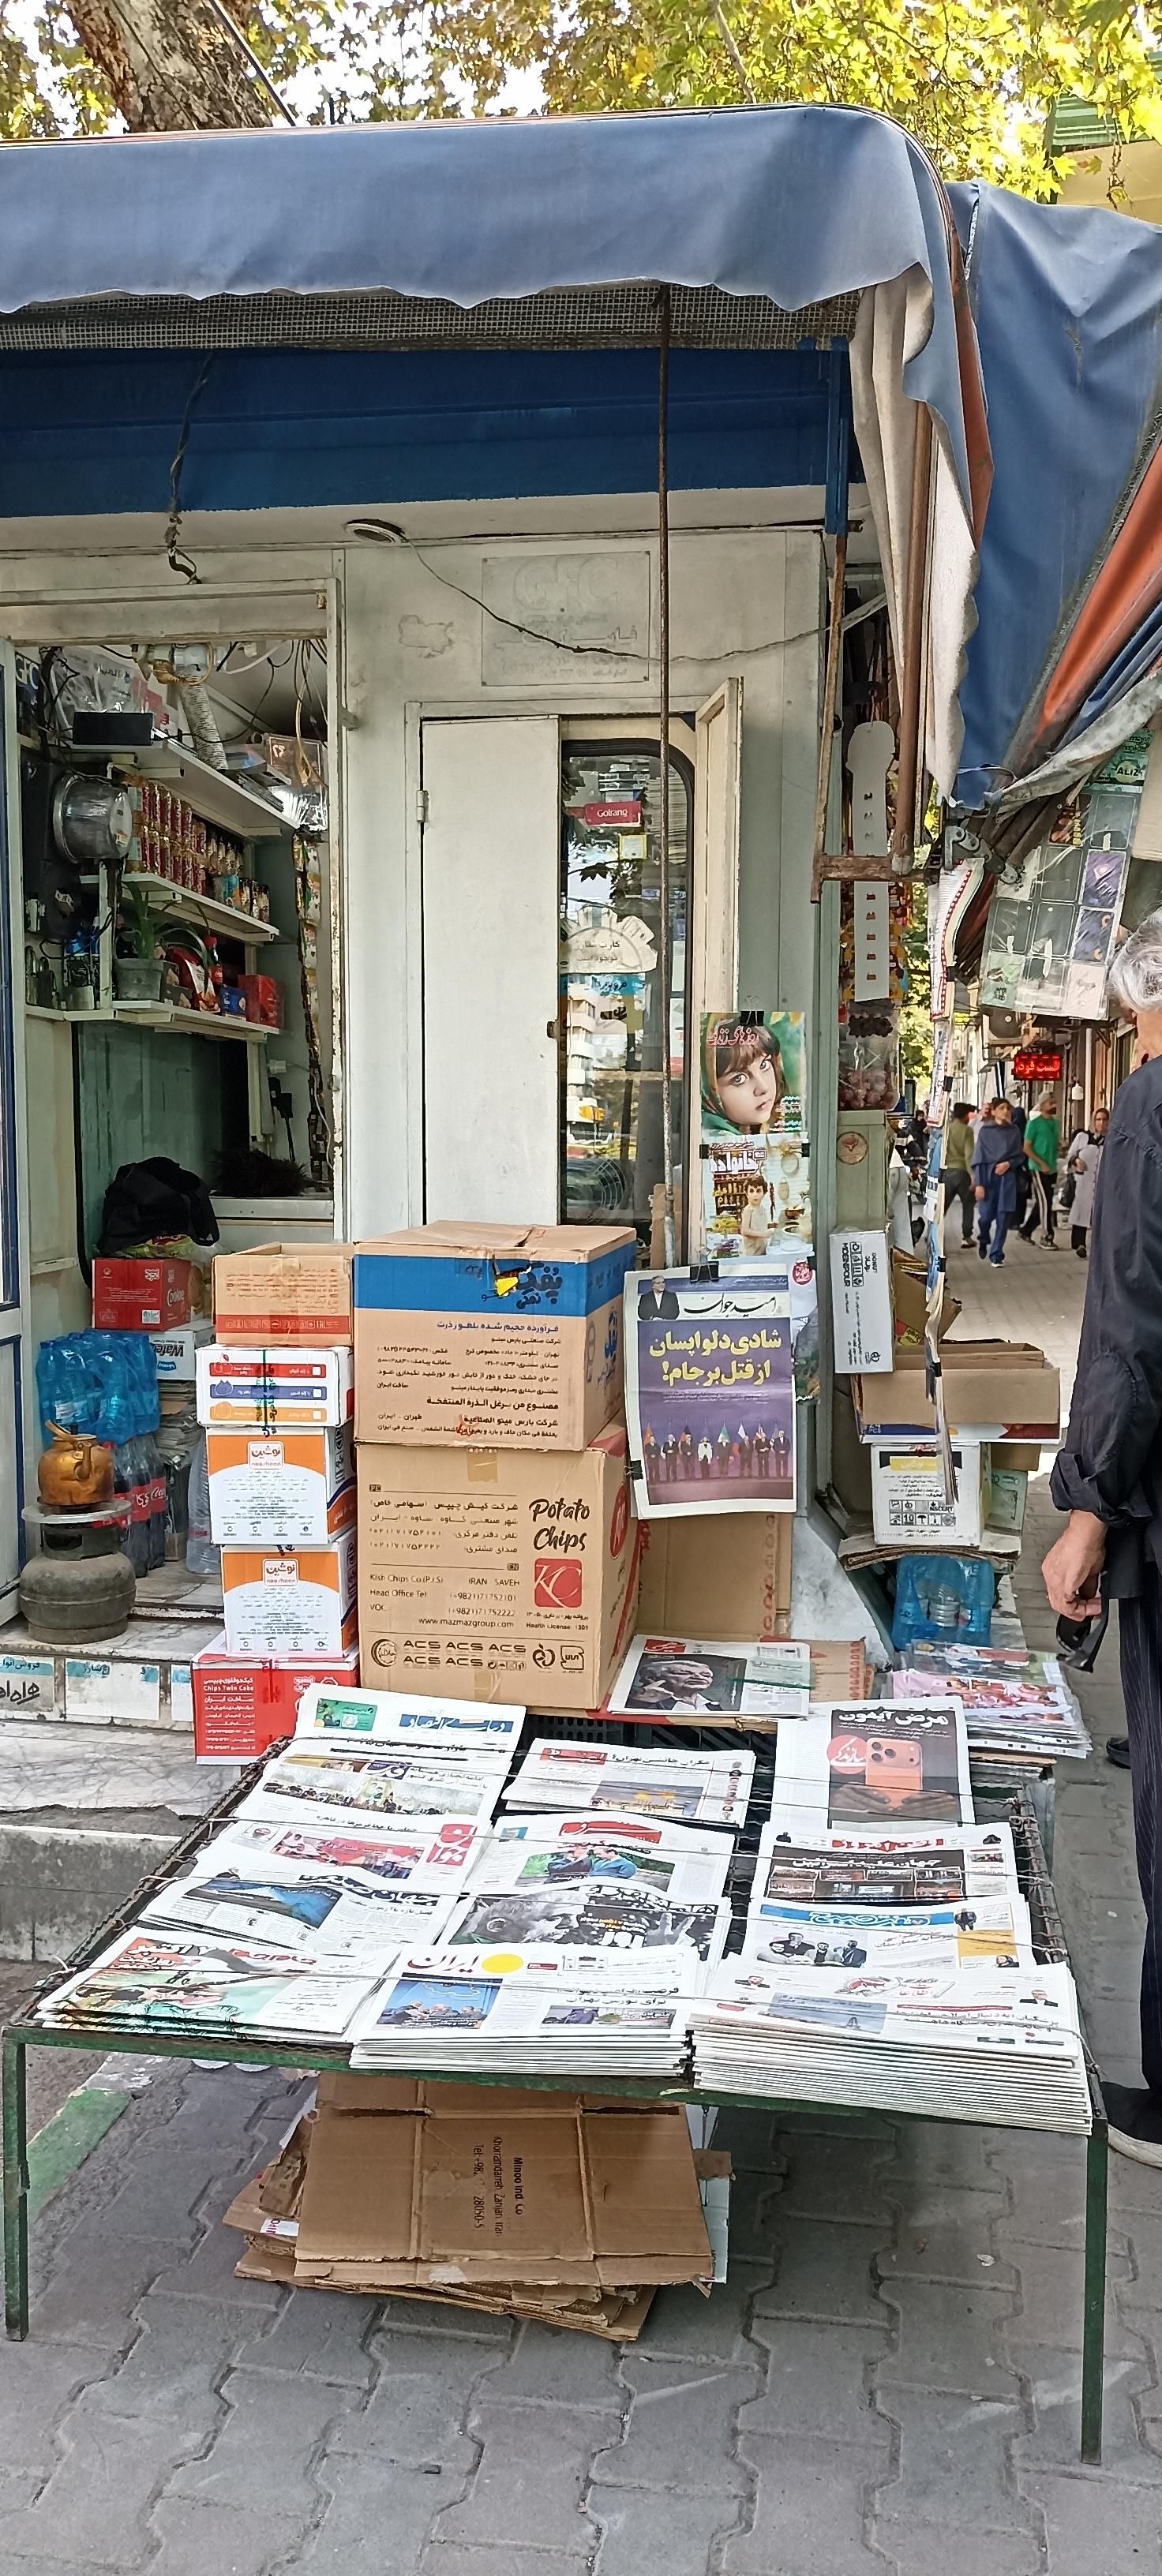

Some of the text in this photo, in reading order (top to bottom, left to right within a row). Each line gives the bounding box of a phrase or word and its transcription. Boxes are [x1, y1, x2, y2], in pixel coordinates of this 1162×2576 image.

[597, 807, 628, 818] Golrang
[167, 1289, 184, 1307] Cookie
[649, 1329, 782, 1357] شادی دلواپسان
[721, 1358, 755, 1386] قتل
[753, 1359, 770, 1386] از
[251, 1445, 281, 1459] نوشین
[463, 1502, 489, 1511] کیش
[490, 1503, 519, 1512] شرکت
[528, 1497, 590, 1522] Potato
[533, 1526, 587, 1554] Chips
[266, 1562, 295, 1576] نوشین
[388, 1574, 410, 1583] Chips
[369, 1589, 390, 1597] Head
[418, 1617, 515, 1628] www.mazmazgroup.com
[403, 1639, 527, 1653] ACS ACS ACS
[403, 1655, 484, 1667] ACS ACS
[838, 1710, 950, 1728] مرض آیفون
[407, 1953, 480, 1973] ایران
[514, 2157, 523, 2184] Minoo
[493, 2193, 505, 2218] Zanjan
